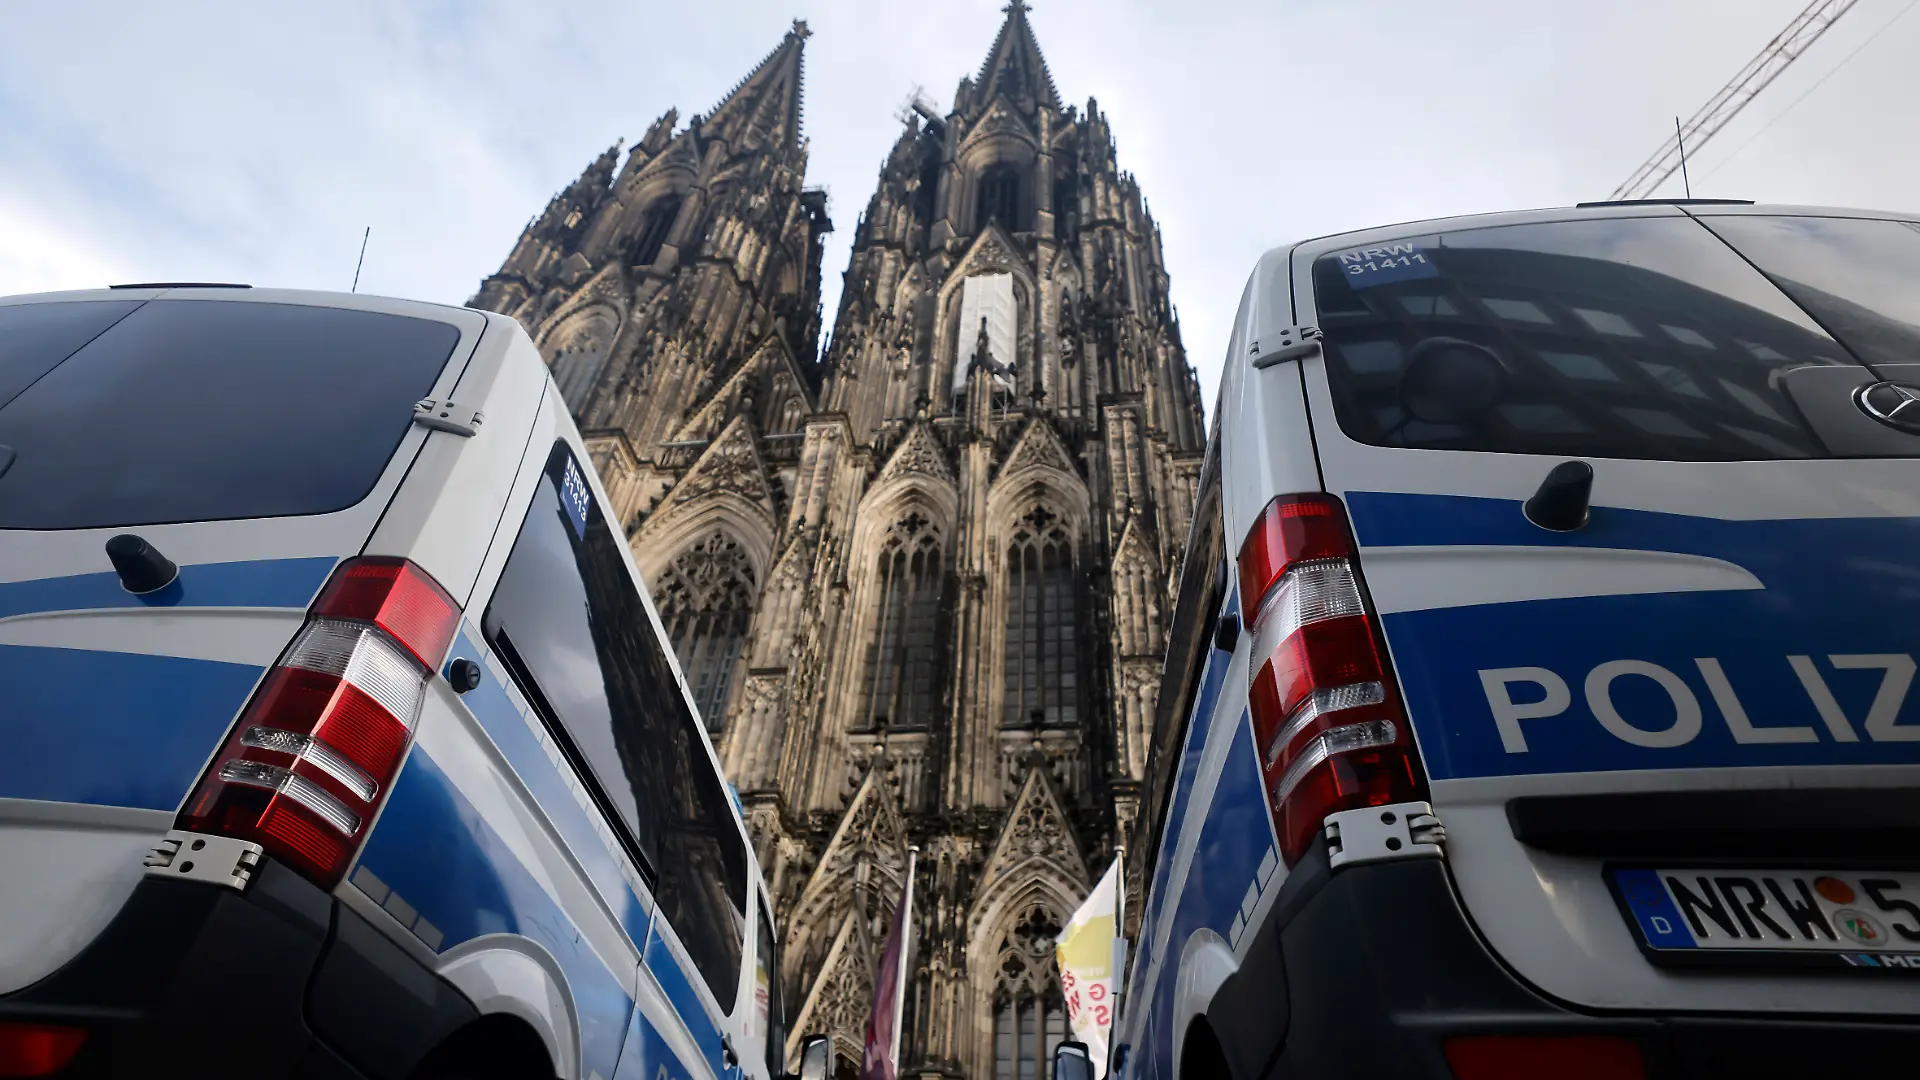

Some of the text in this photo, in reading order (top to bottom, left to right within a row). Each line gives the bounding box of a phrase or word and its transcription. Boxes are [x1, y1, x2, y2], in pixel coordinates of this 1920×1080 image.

[1340, 243, 1413, 264] NRW
[1348, 254, 1426, 275] 31411
[564, 472, 586, 521] 31413
[568, 456, 590, 505] NRW
[1478, 653, 1920, 754] POLIZ
[1651, 916, 1672, 934] D
[1665, 876, 1920, 941] NRW 5
